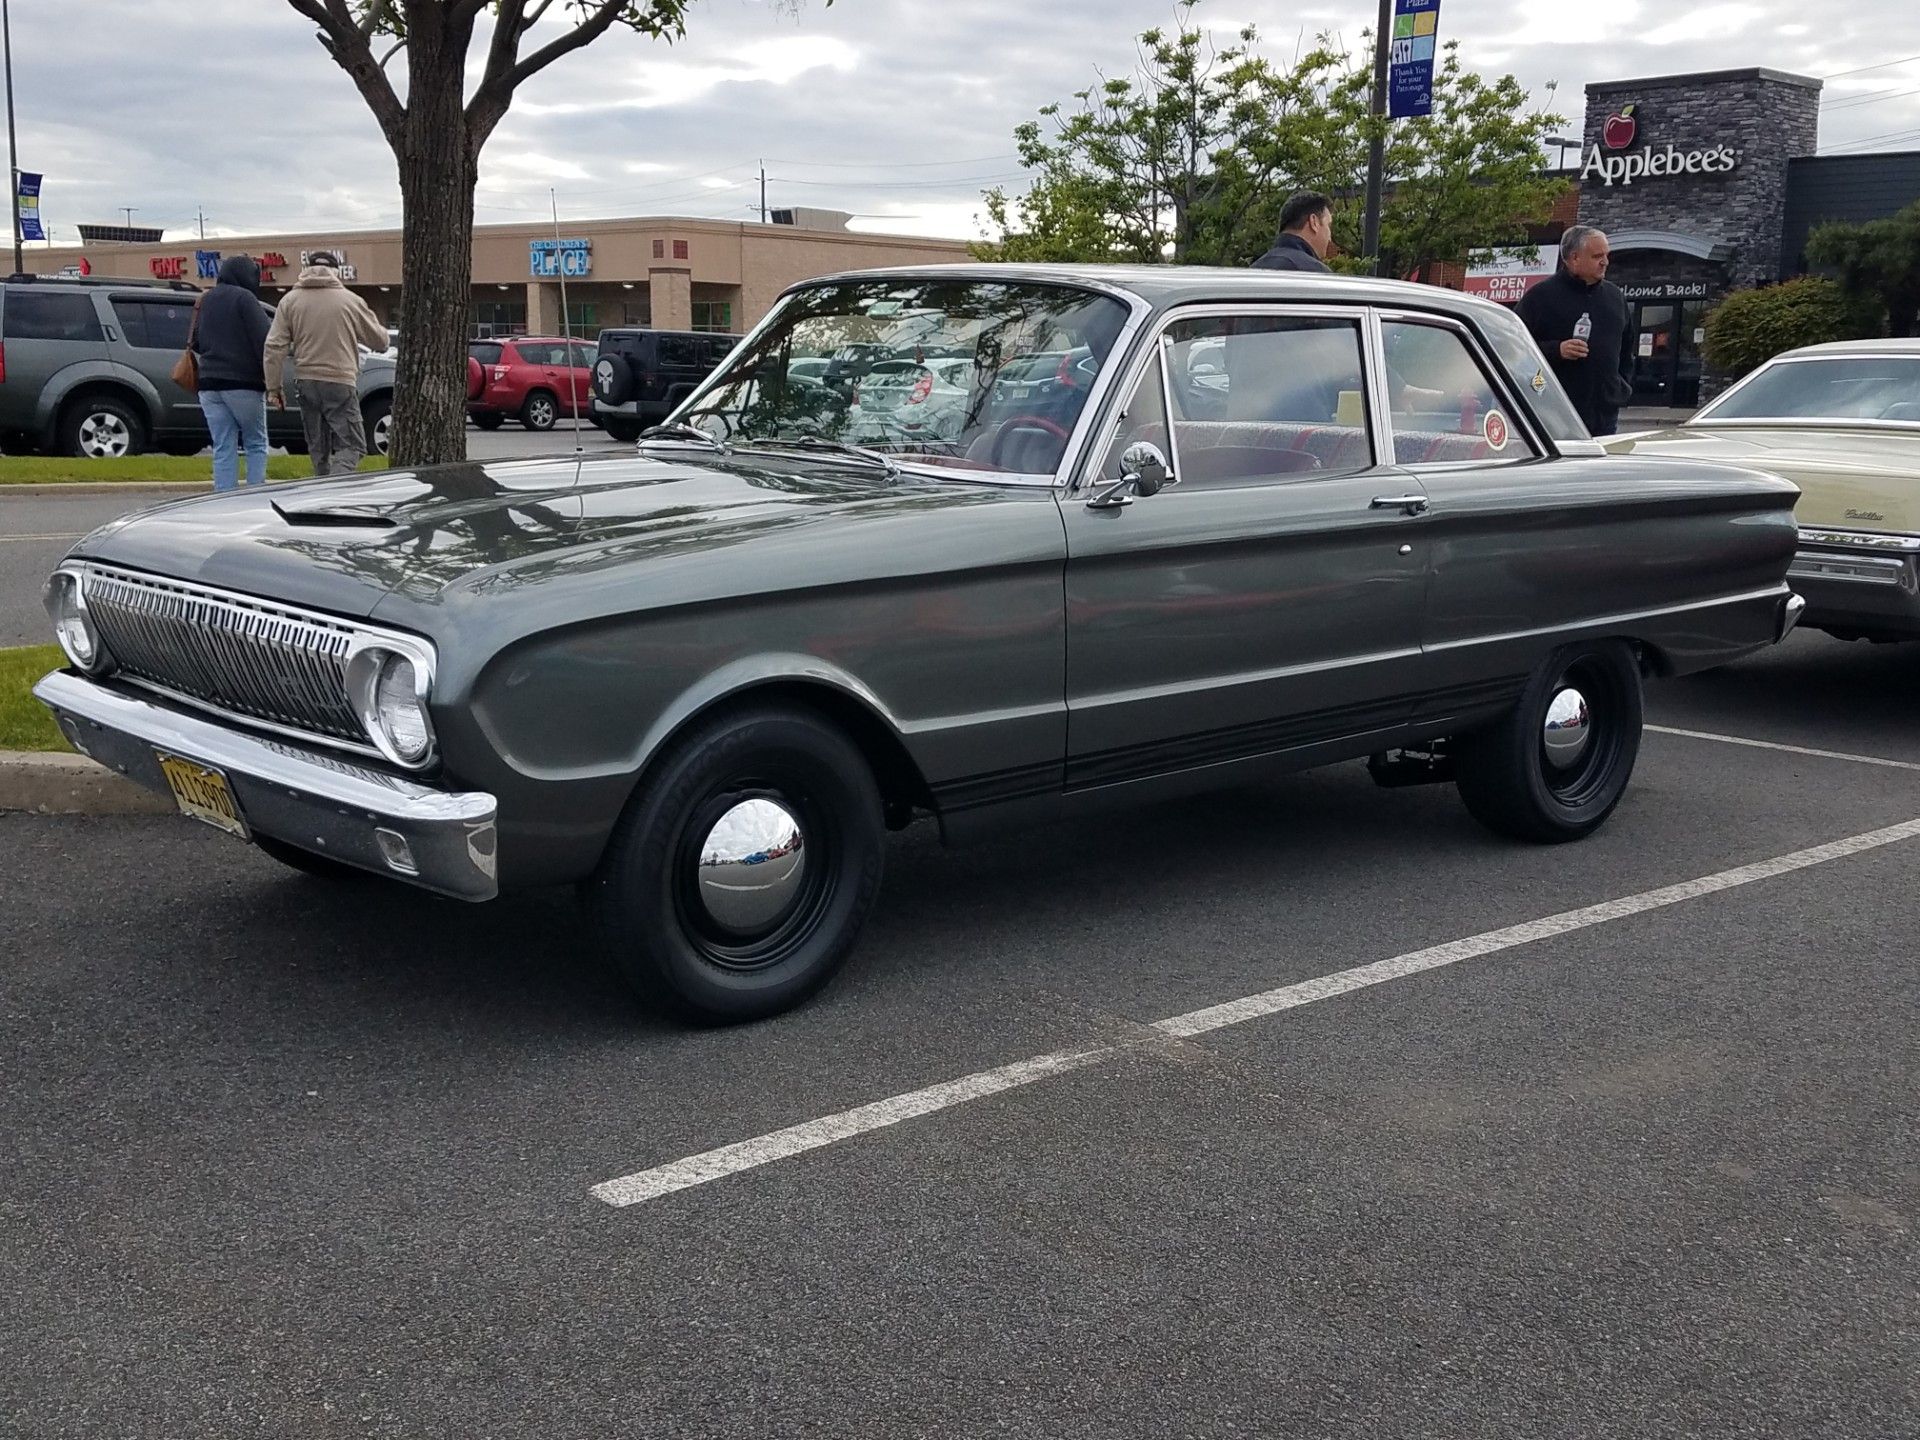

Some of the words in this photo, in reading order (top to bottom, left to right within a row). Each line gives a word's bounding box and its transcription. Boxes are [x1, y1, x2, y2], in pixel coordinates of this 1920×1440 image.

[1395, 67, 1413, 76] Thank
[1415, 65, 1427, 74] You
[1398, 76, 1407, 84] for
[1408, 76, 1422, 84] your
[1396, 84, 1425, 93] Patronage
[1580, 143, 1735, 186] Applebee's
[149, 256, 188, 275] GNC
[529, 249, 588, 276] PLACE
[1489, 277, 1527, 289] OPEN
[1665, 282, 1706, 296] Back!
[1489, 289, 1508, 300] AND
